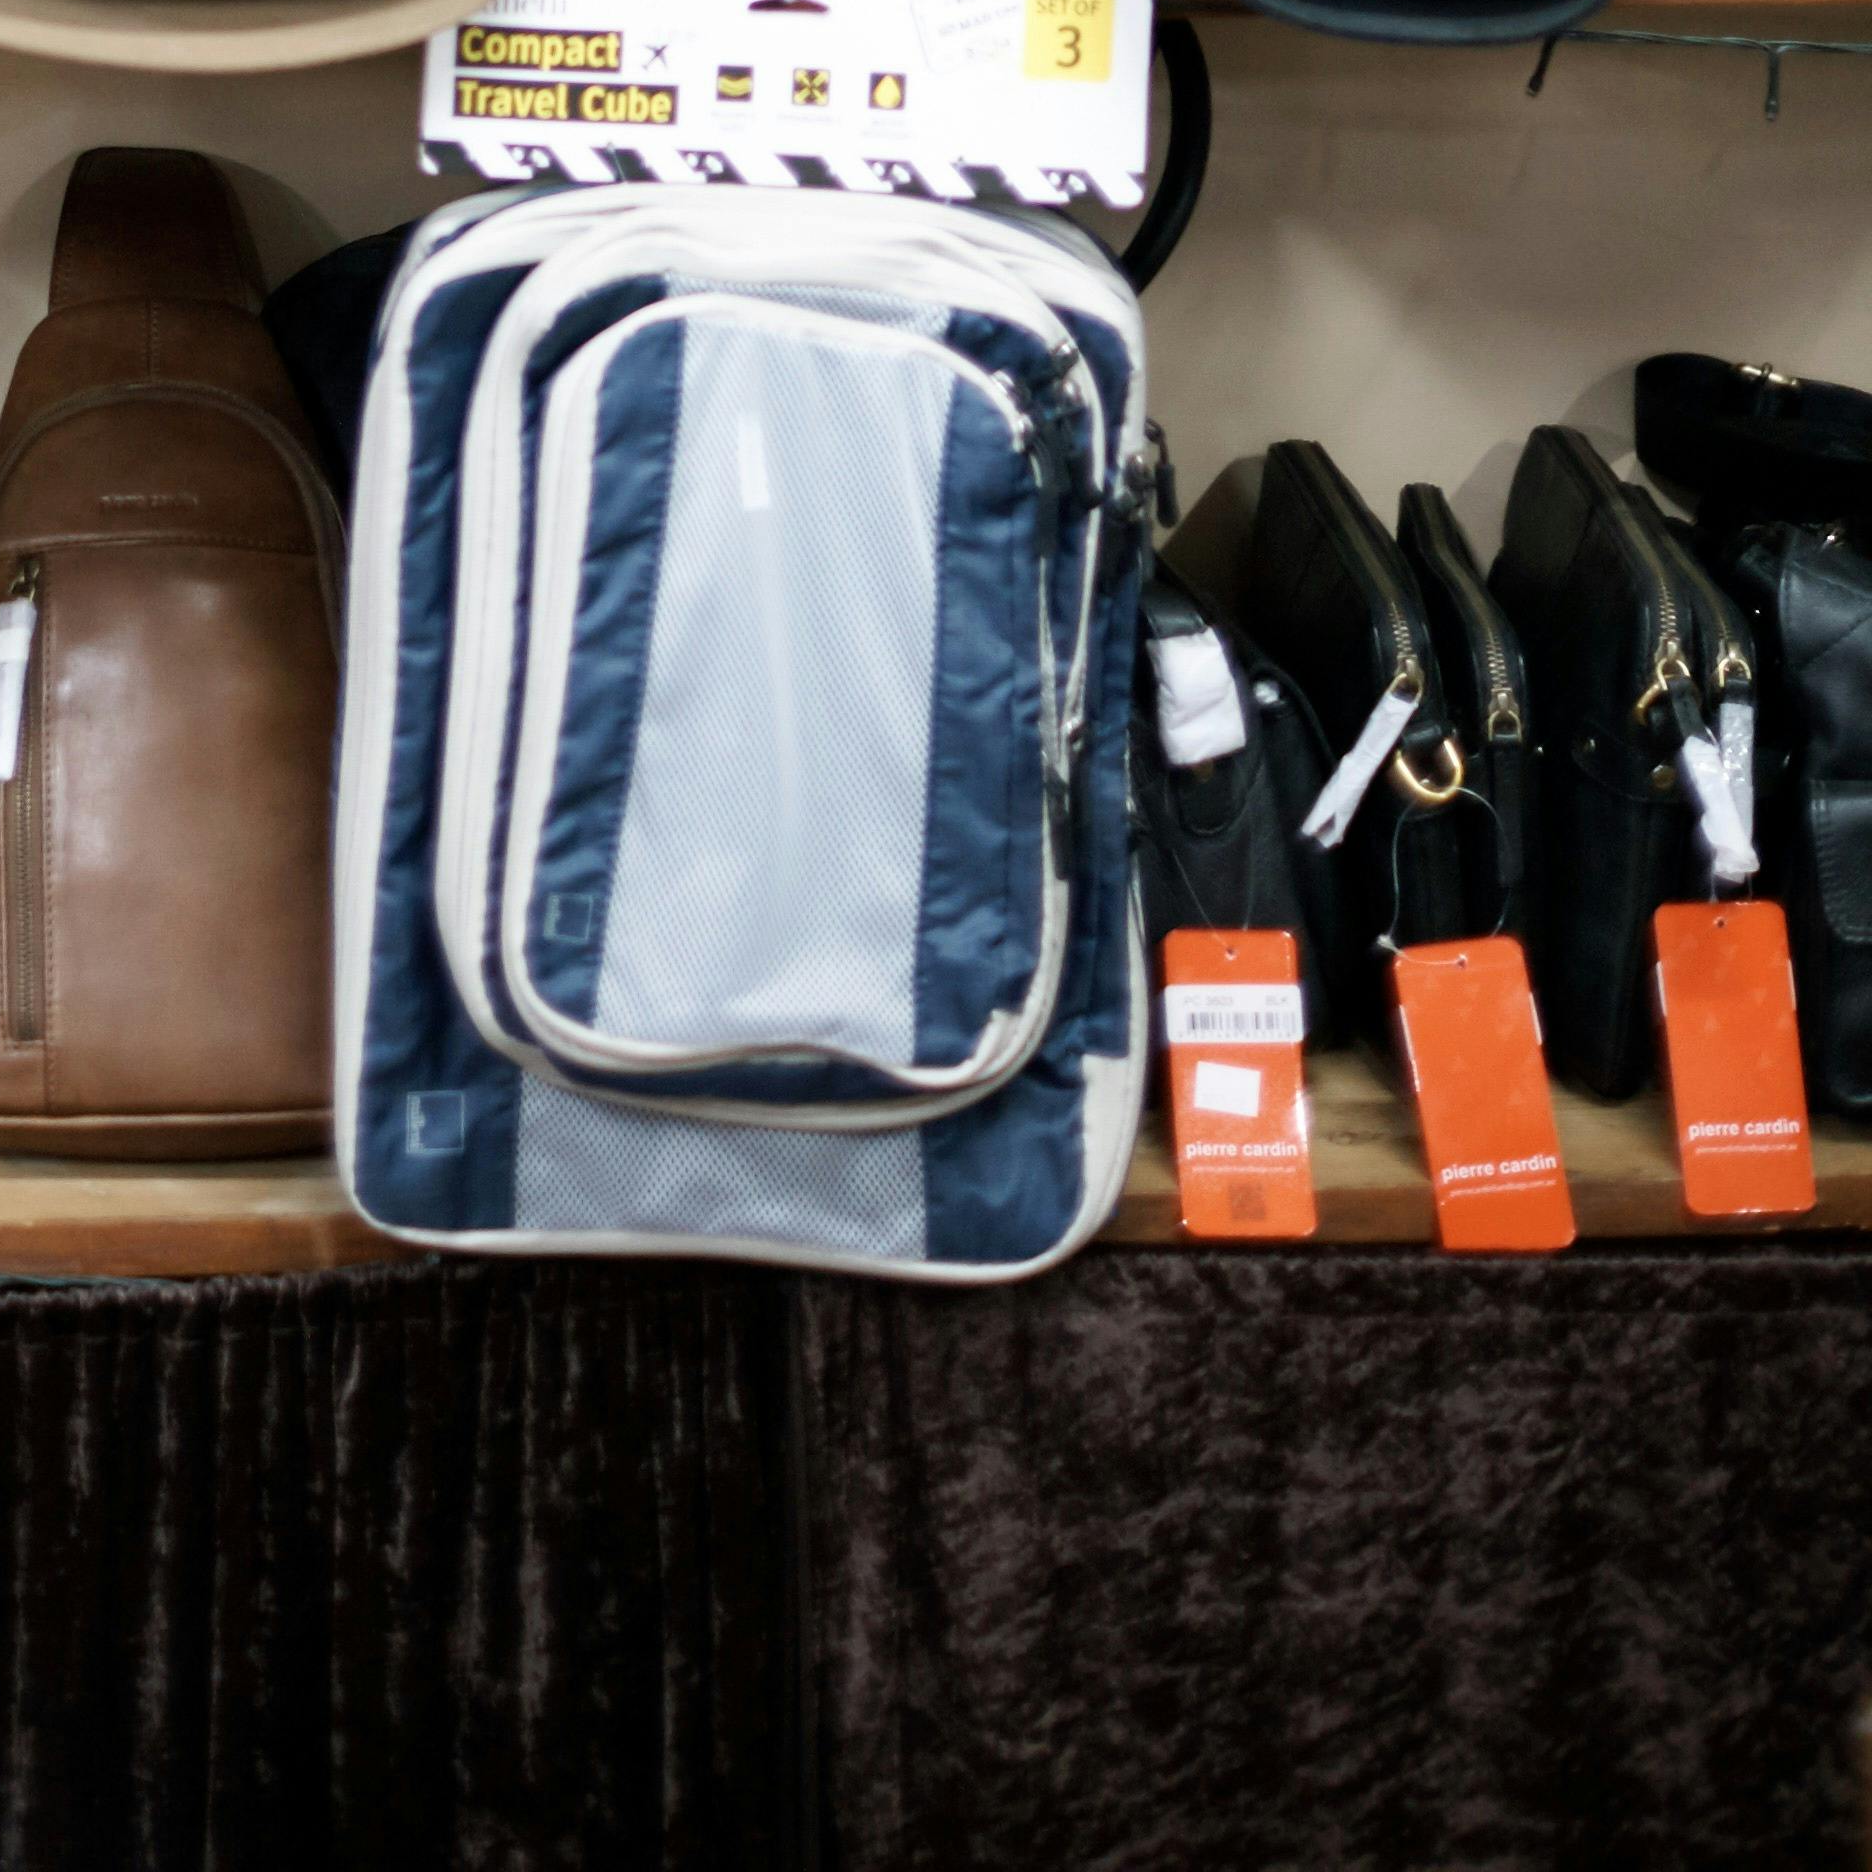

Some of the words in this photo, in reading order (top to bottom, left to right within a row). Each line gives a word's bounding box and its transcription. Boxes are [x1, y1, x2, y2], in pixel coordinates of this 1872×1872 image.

[1074, 0, 1102, 17] OF
[460, 26, 621, 71] Compact
[1055, 24, 1082, 69] 3
[457, 80, 569, 120] Travel
[580, 85, 673, 124] Cube
[1687, 1121, 1740, 1141] pierre
[1743, 1117, 1801, 1135] cardin
[1185, 1140, 1237, 1161] pierre
[1242, 1140, 1298, 1157] cardin
[1440, 1163, 1495, 1184] pierre
[1499, 1154, 1558, 1175] cardin
